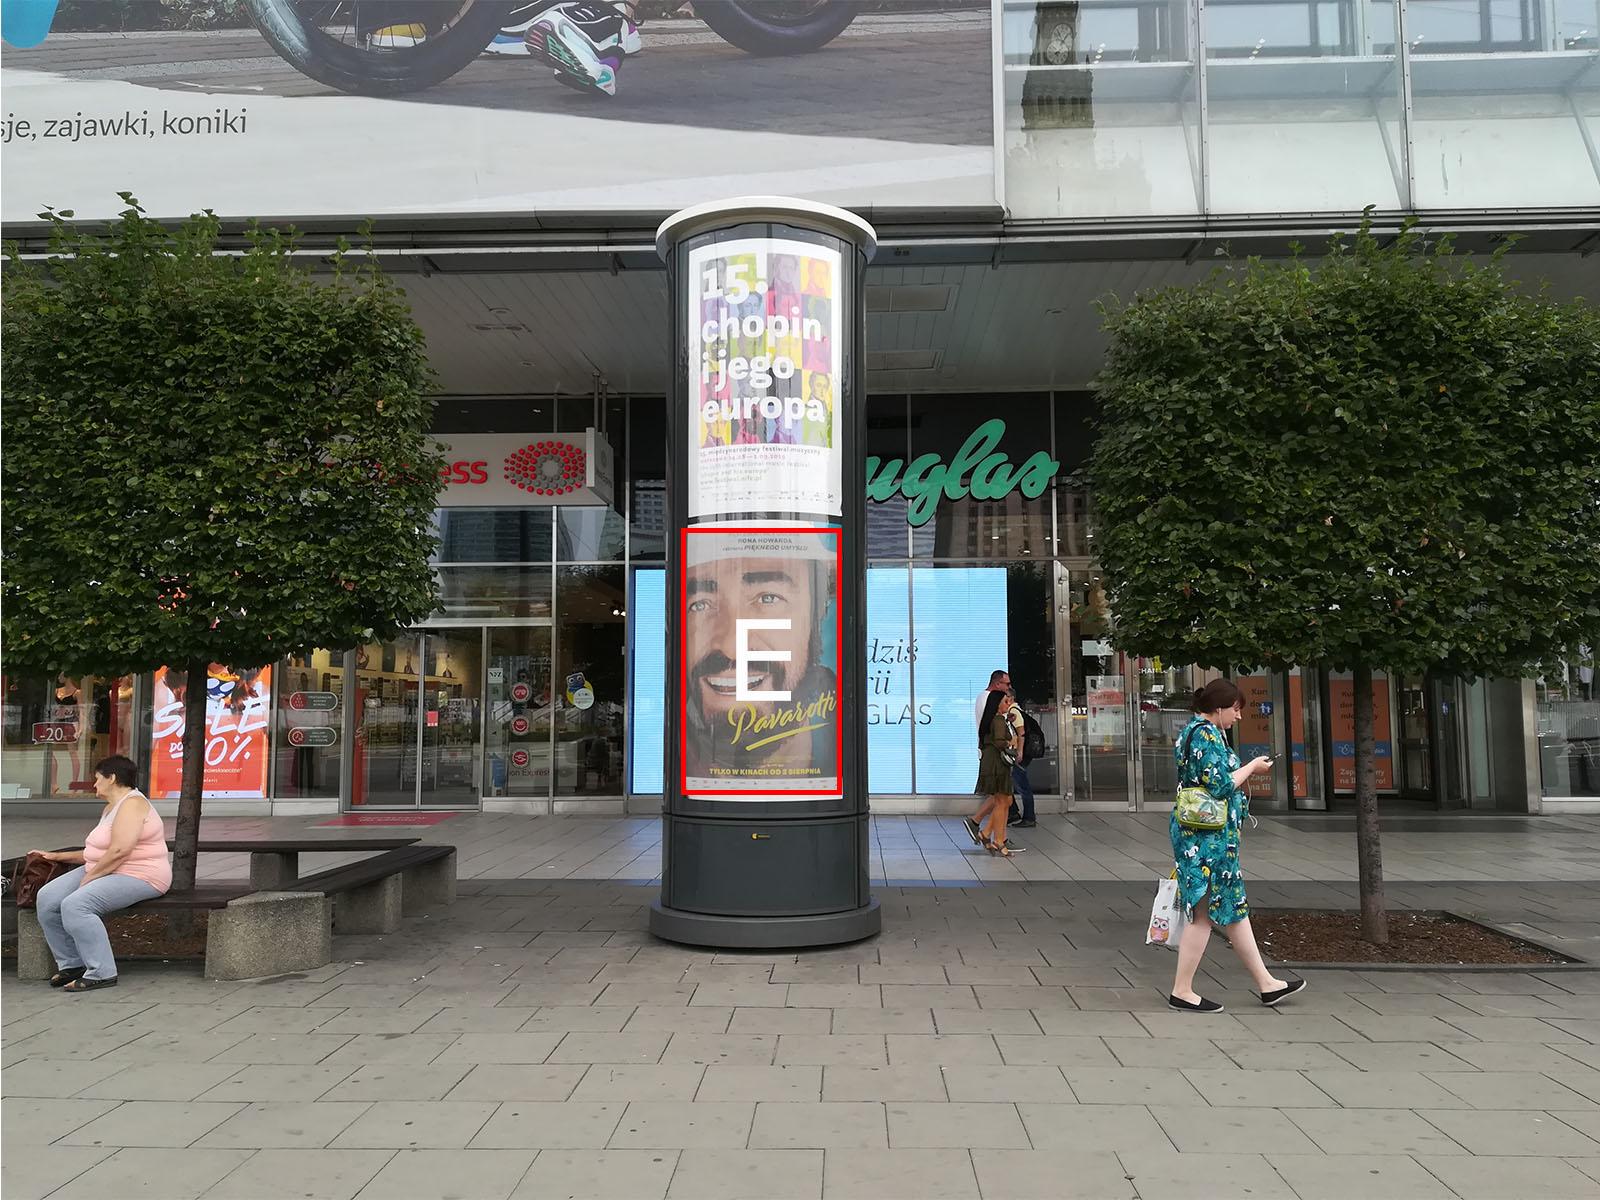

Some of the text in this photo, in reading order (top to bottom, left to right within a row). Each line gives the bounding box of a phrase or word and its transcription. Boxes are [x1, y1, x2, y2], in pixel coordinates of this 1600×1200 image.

[43, 111, 155, 142] zajawki,
[162, 108, 247, 135] koniki
[702, 306, 822, 347] chopin
[702, 349, 795, 392] i jego
[702, 396, 825, 429] europa
[867, 419, 1060, 526] uglas
[727, 689, 837, 745] Pavarotti
[868, 703, 932, 725] GLAS
